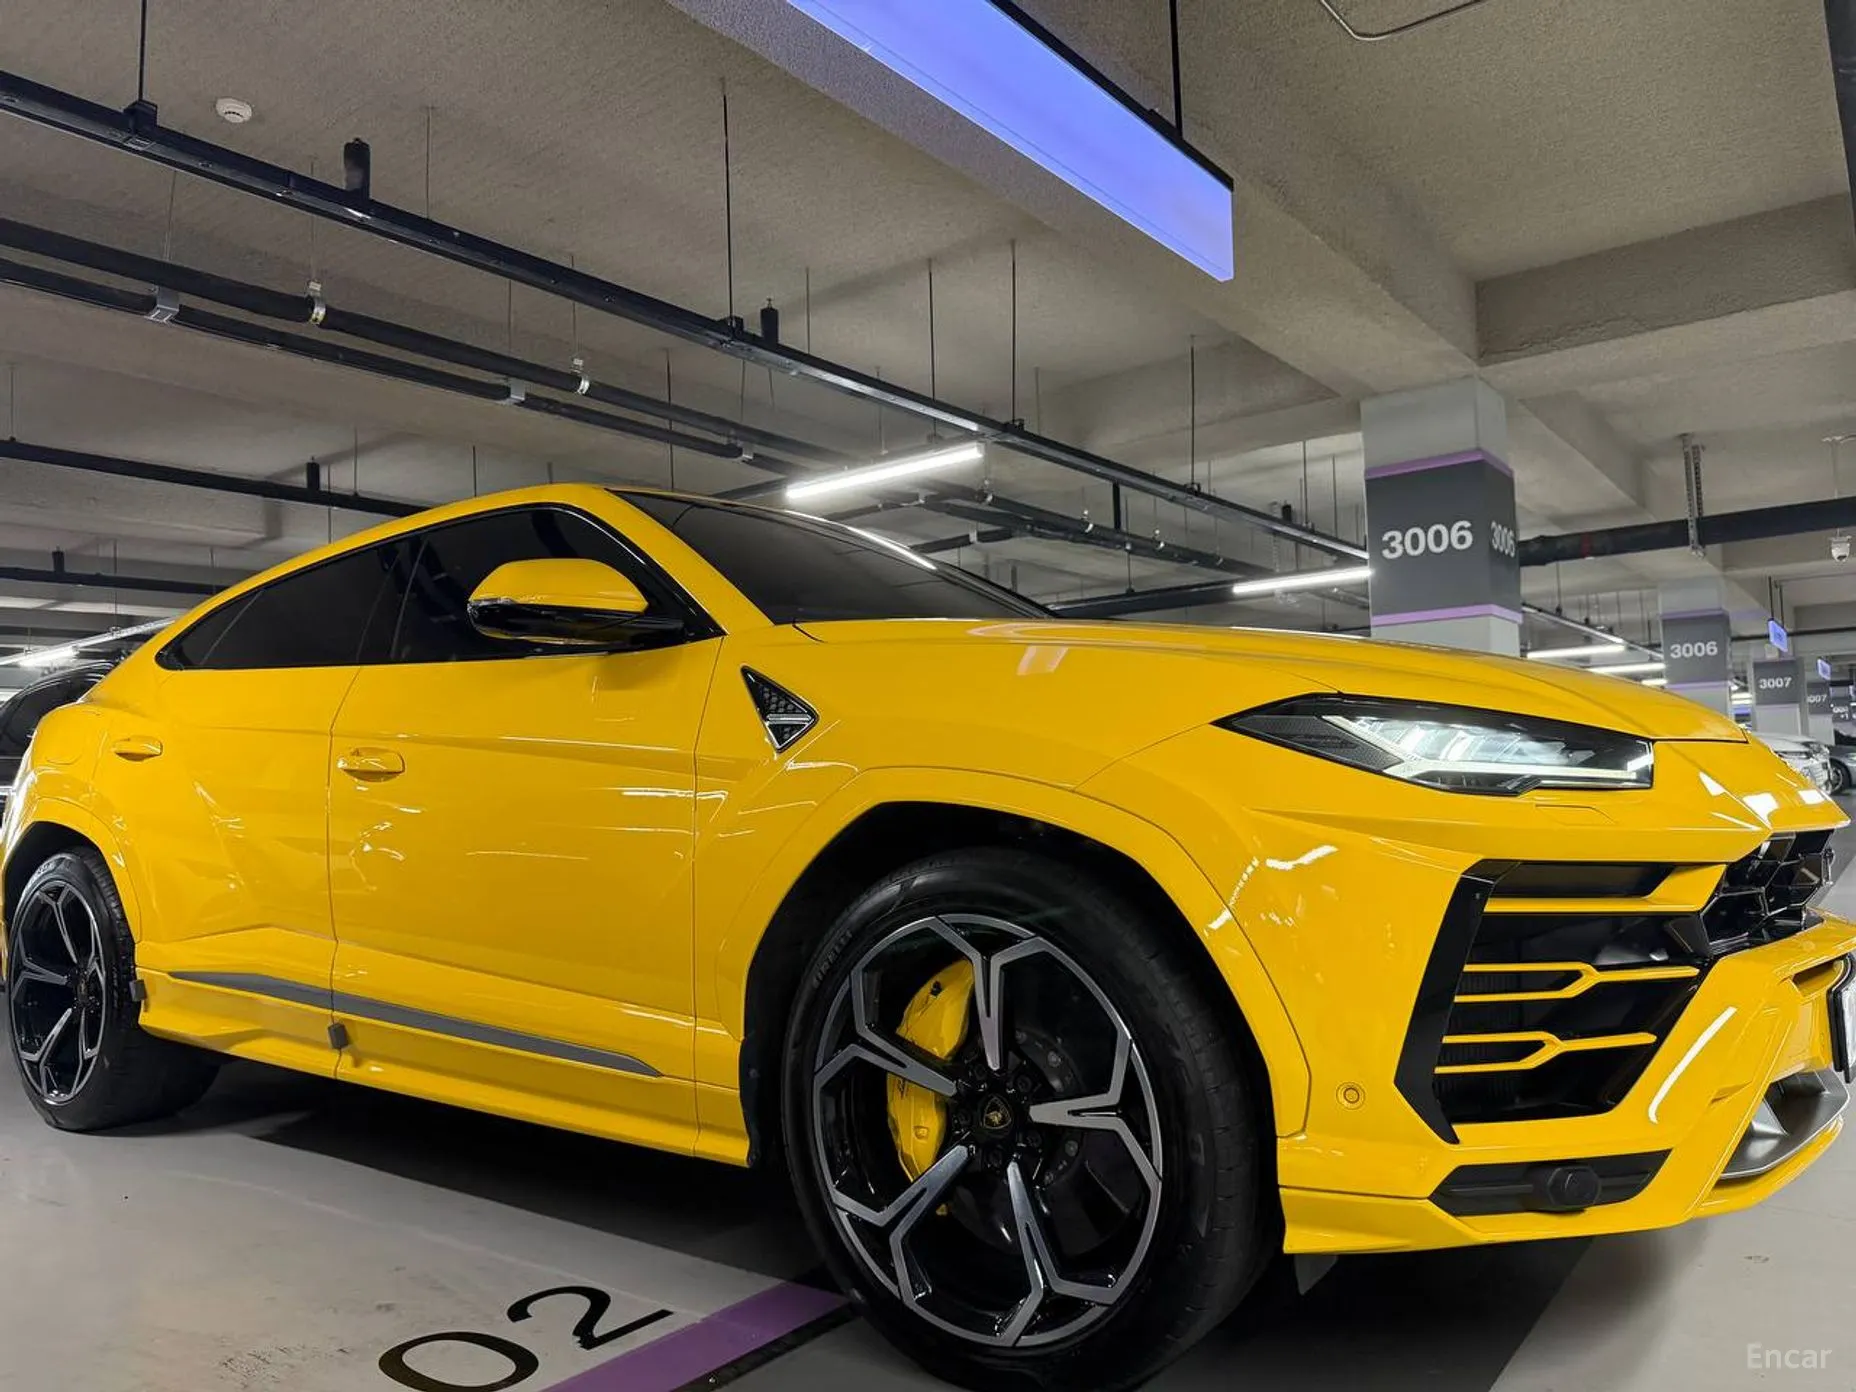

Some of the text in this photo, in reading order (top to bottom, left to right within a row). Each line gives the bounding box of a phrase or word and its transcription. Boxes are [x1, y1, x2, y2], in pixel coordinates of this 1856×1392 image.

[1382, 520, 1473, 559] 3006
[1670, 641, 1718, 658] 3006
[1759, 677, 1793, 690] 3007
[378, 1286, 674, 1392] 02
